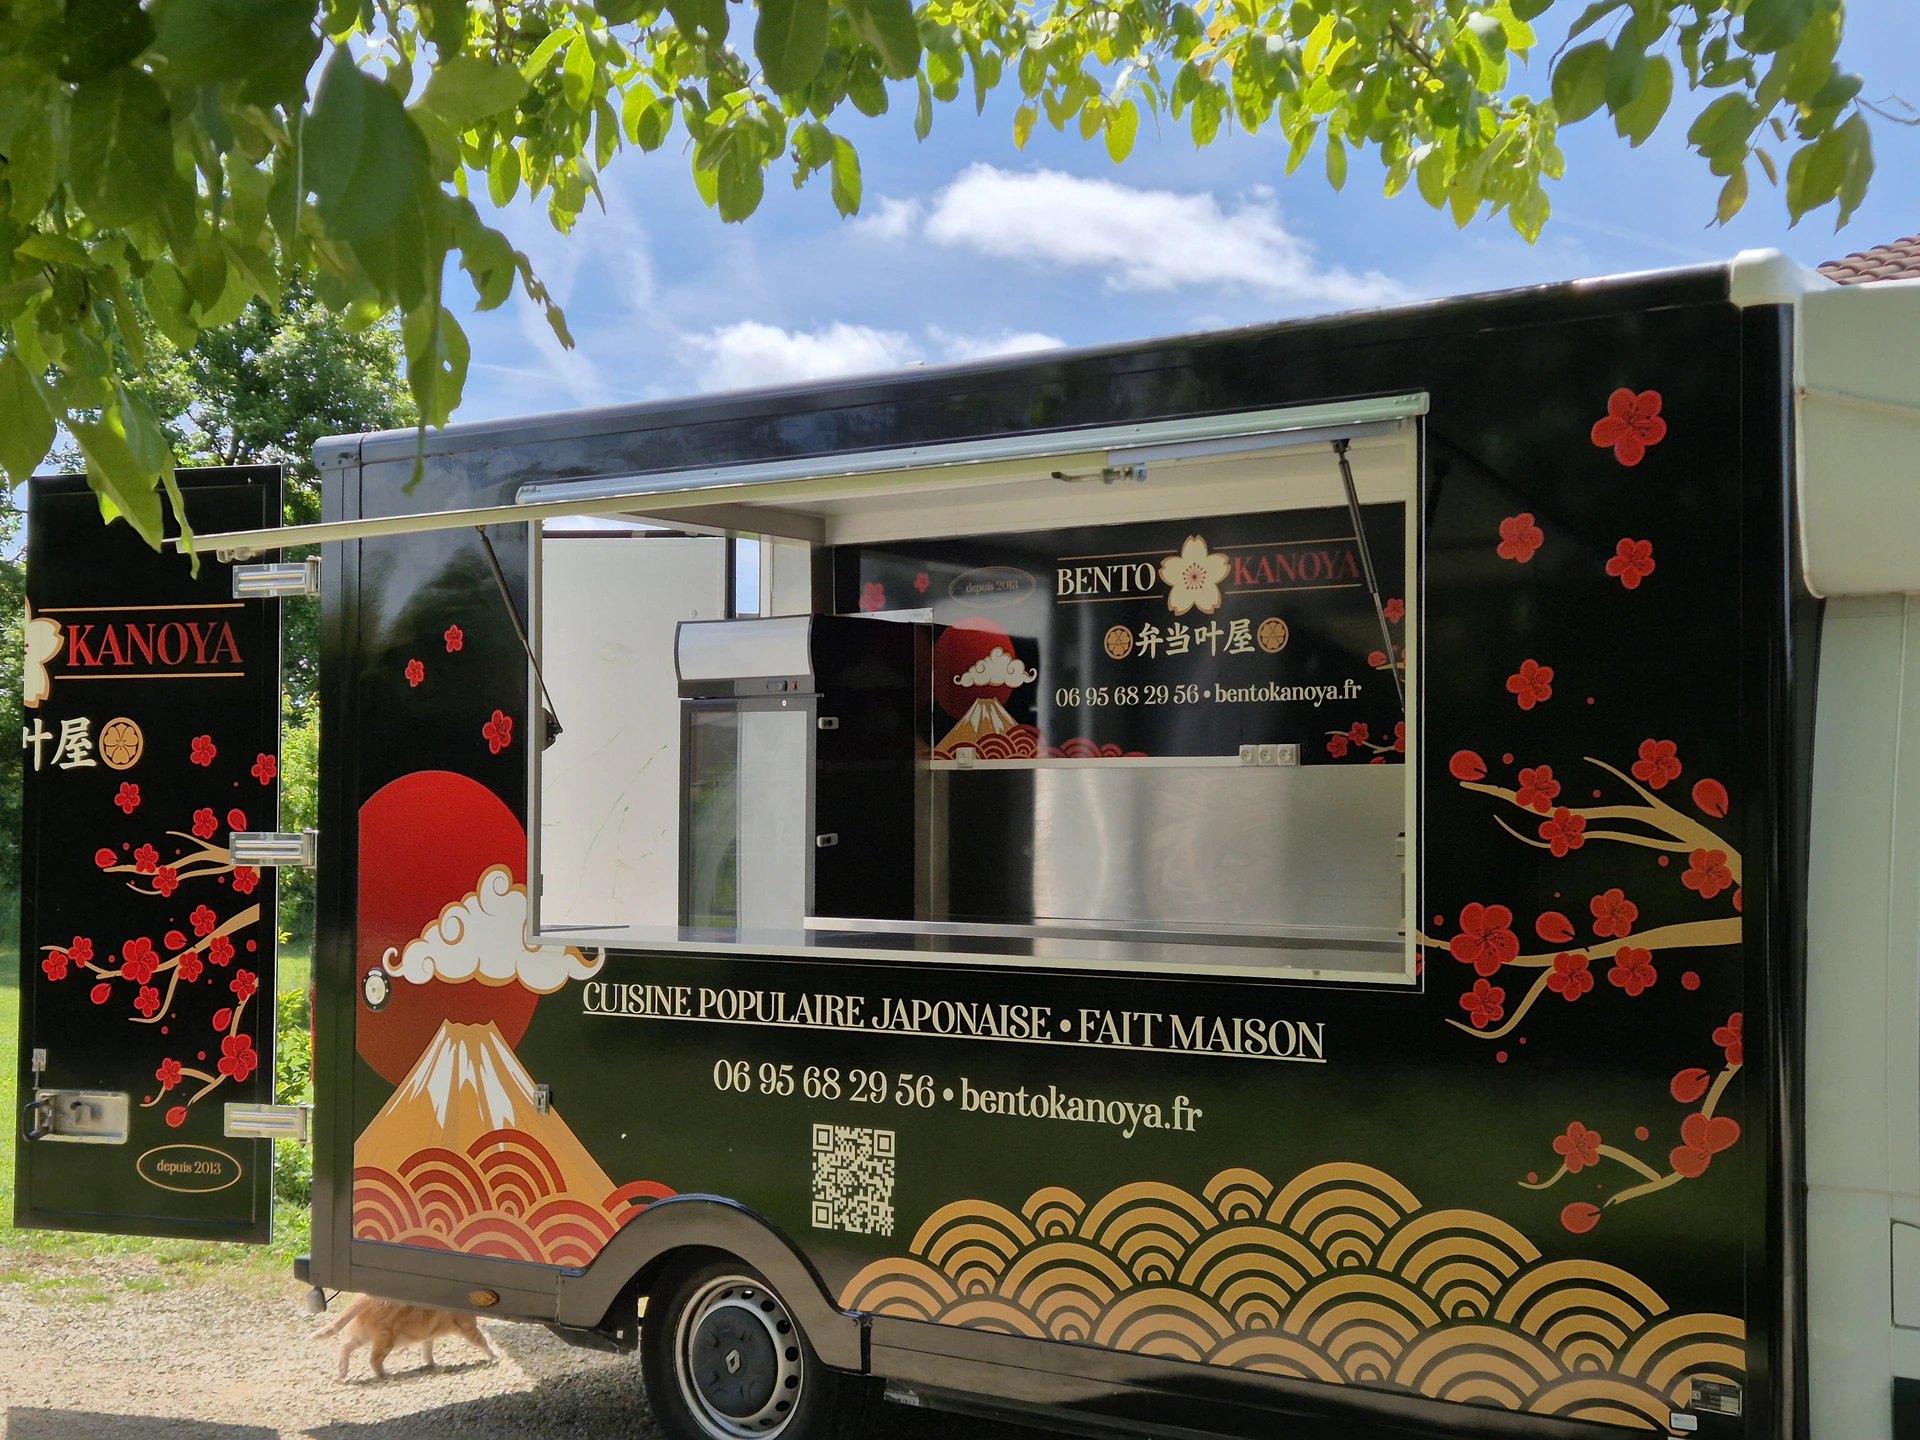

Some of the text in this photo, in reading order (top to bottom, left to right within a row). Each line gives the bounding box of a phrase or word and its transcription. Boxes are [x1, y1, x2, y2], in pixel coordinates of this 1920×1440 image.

[965, 580, 1019, 594] depuis 2013
[1056, 550, 1360, 596] BENTO KANOYA
[66, 621, 244, 667] KANOYA
[1135, 618, 1256, 659] 弁当叶屋
[1055, 679, 1362, 708] 06 95 68 29 56 bentokanoya.fr
[583, 981, 1326, 1058] CUISINE POPULAIRE JAPONAISE FAIT MAISON
[713, 1059, 1203, 1139] 06 95 68 29 56 bentokanoya.fr
[157, 1159, 221, 1175] depuis 2013
